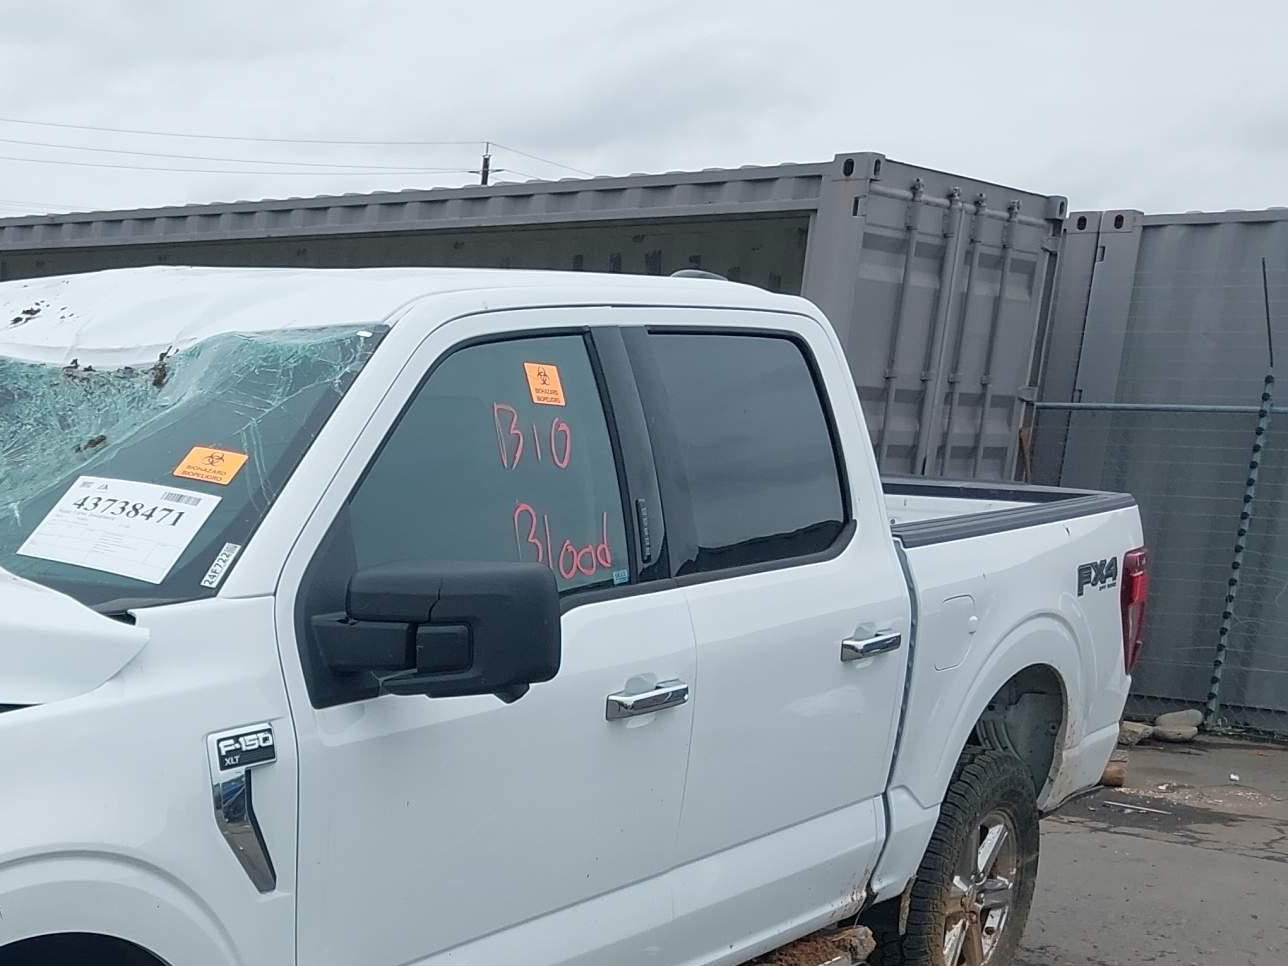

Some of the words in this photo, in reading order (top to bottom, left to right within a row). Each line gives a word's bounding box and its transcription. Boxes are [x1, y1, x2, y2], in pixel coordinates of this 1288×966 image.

[72, 494, 186, 529] 43738471
[513, 500, 612, 579] Blood
[1077, 556, 1118, 597] FX4
[218, 730, 273, 756] F-150
[224, 755, 240, 767] XLT
